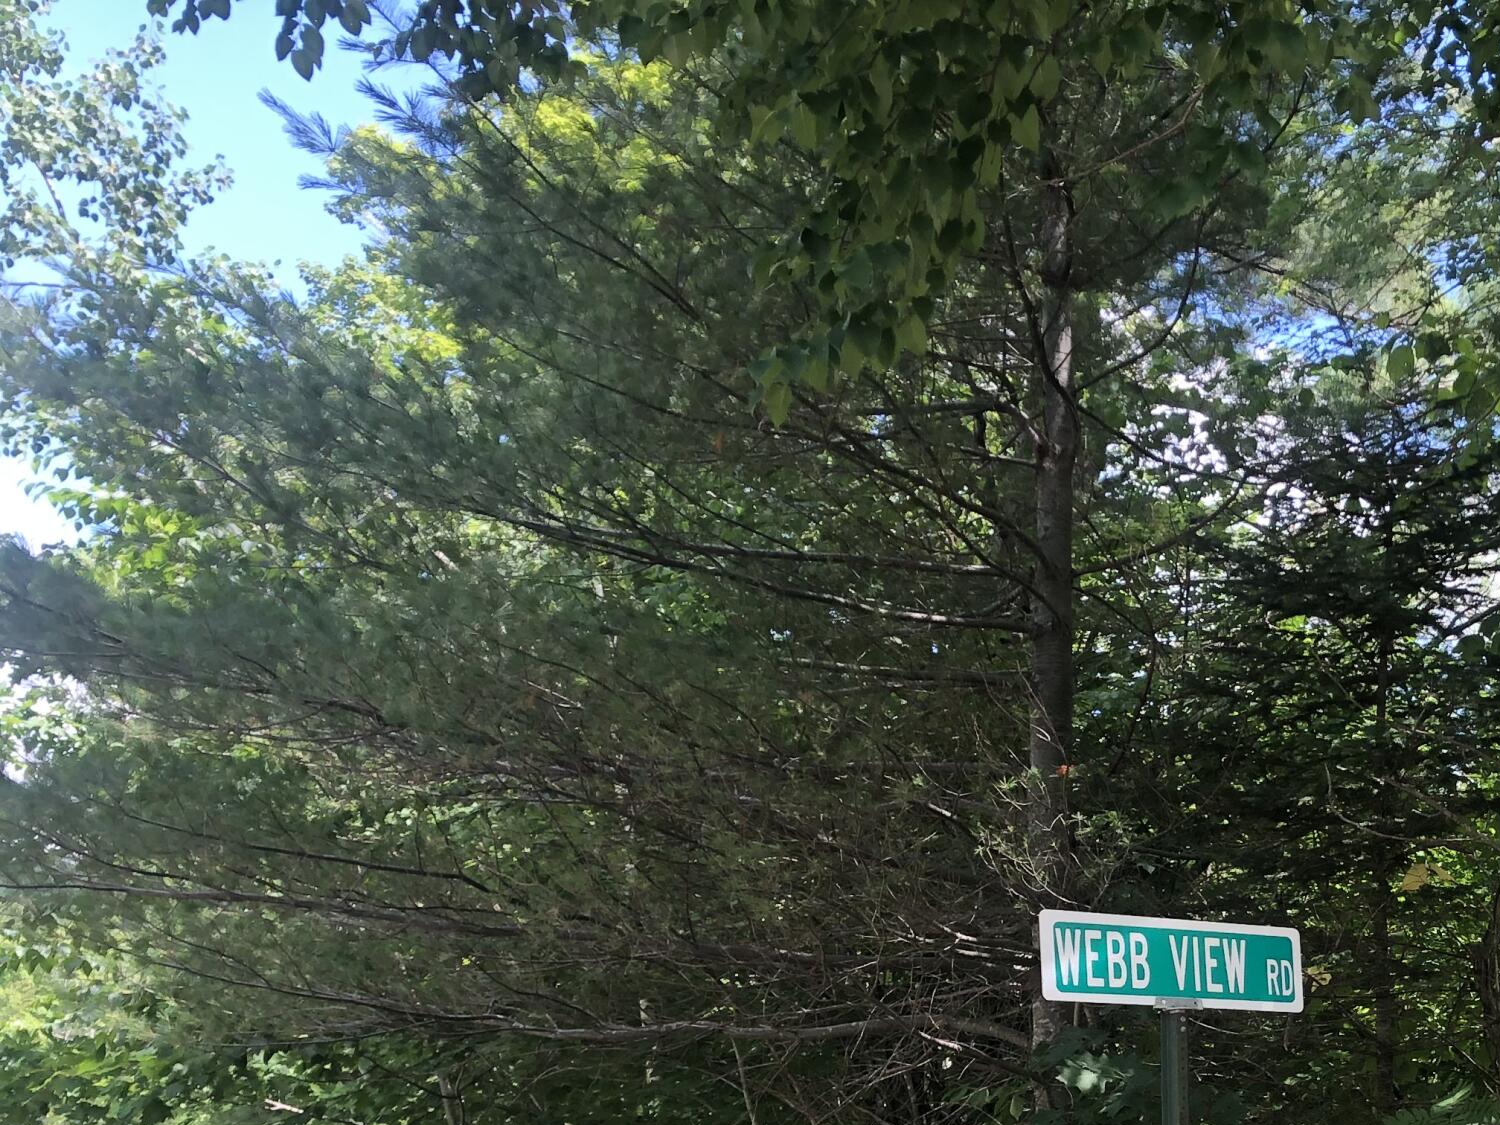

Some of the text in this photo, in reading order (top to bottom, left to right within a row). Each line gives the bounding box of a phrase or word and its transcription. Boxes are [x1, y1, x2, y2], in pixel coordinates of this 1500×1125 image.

[1055, 927, 1294, 997] WEBB VIEW RD
